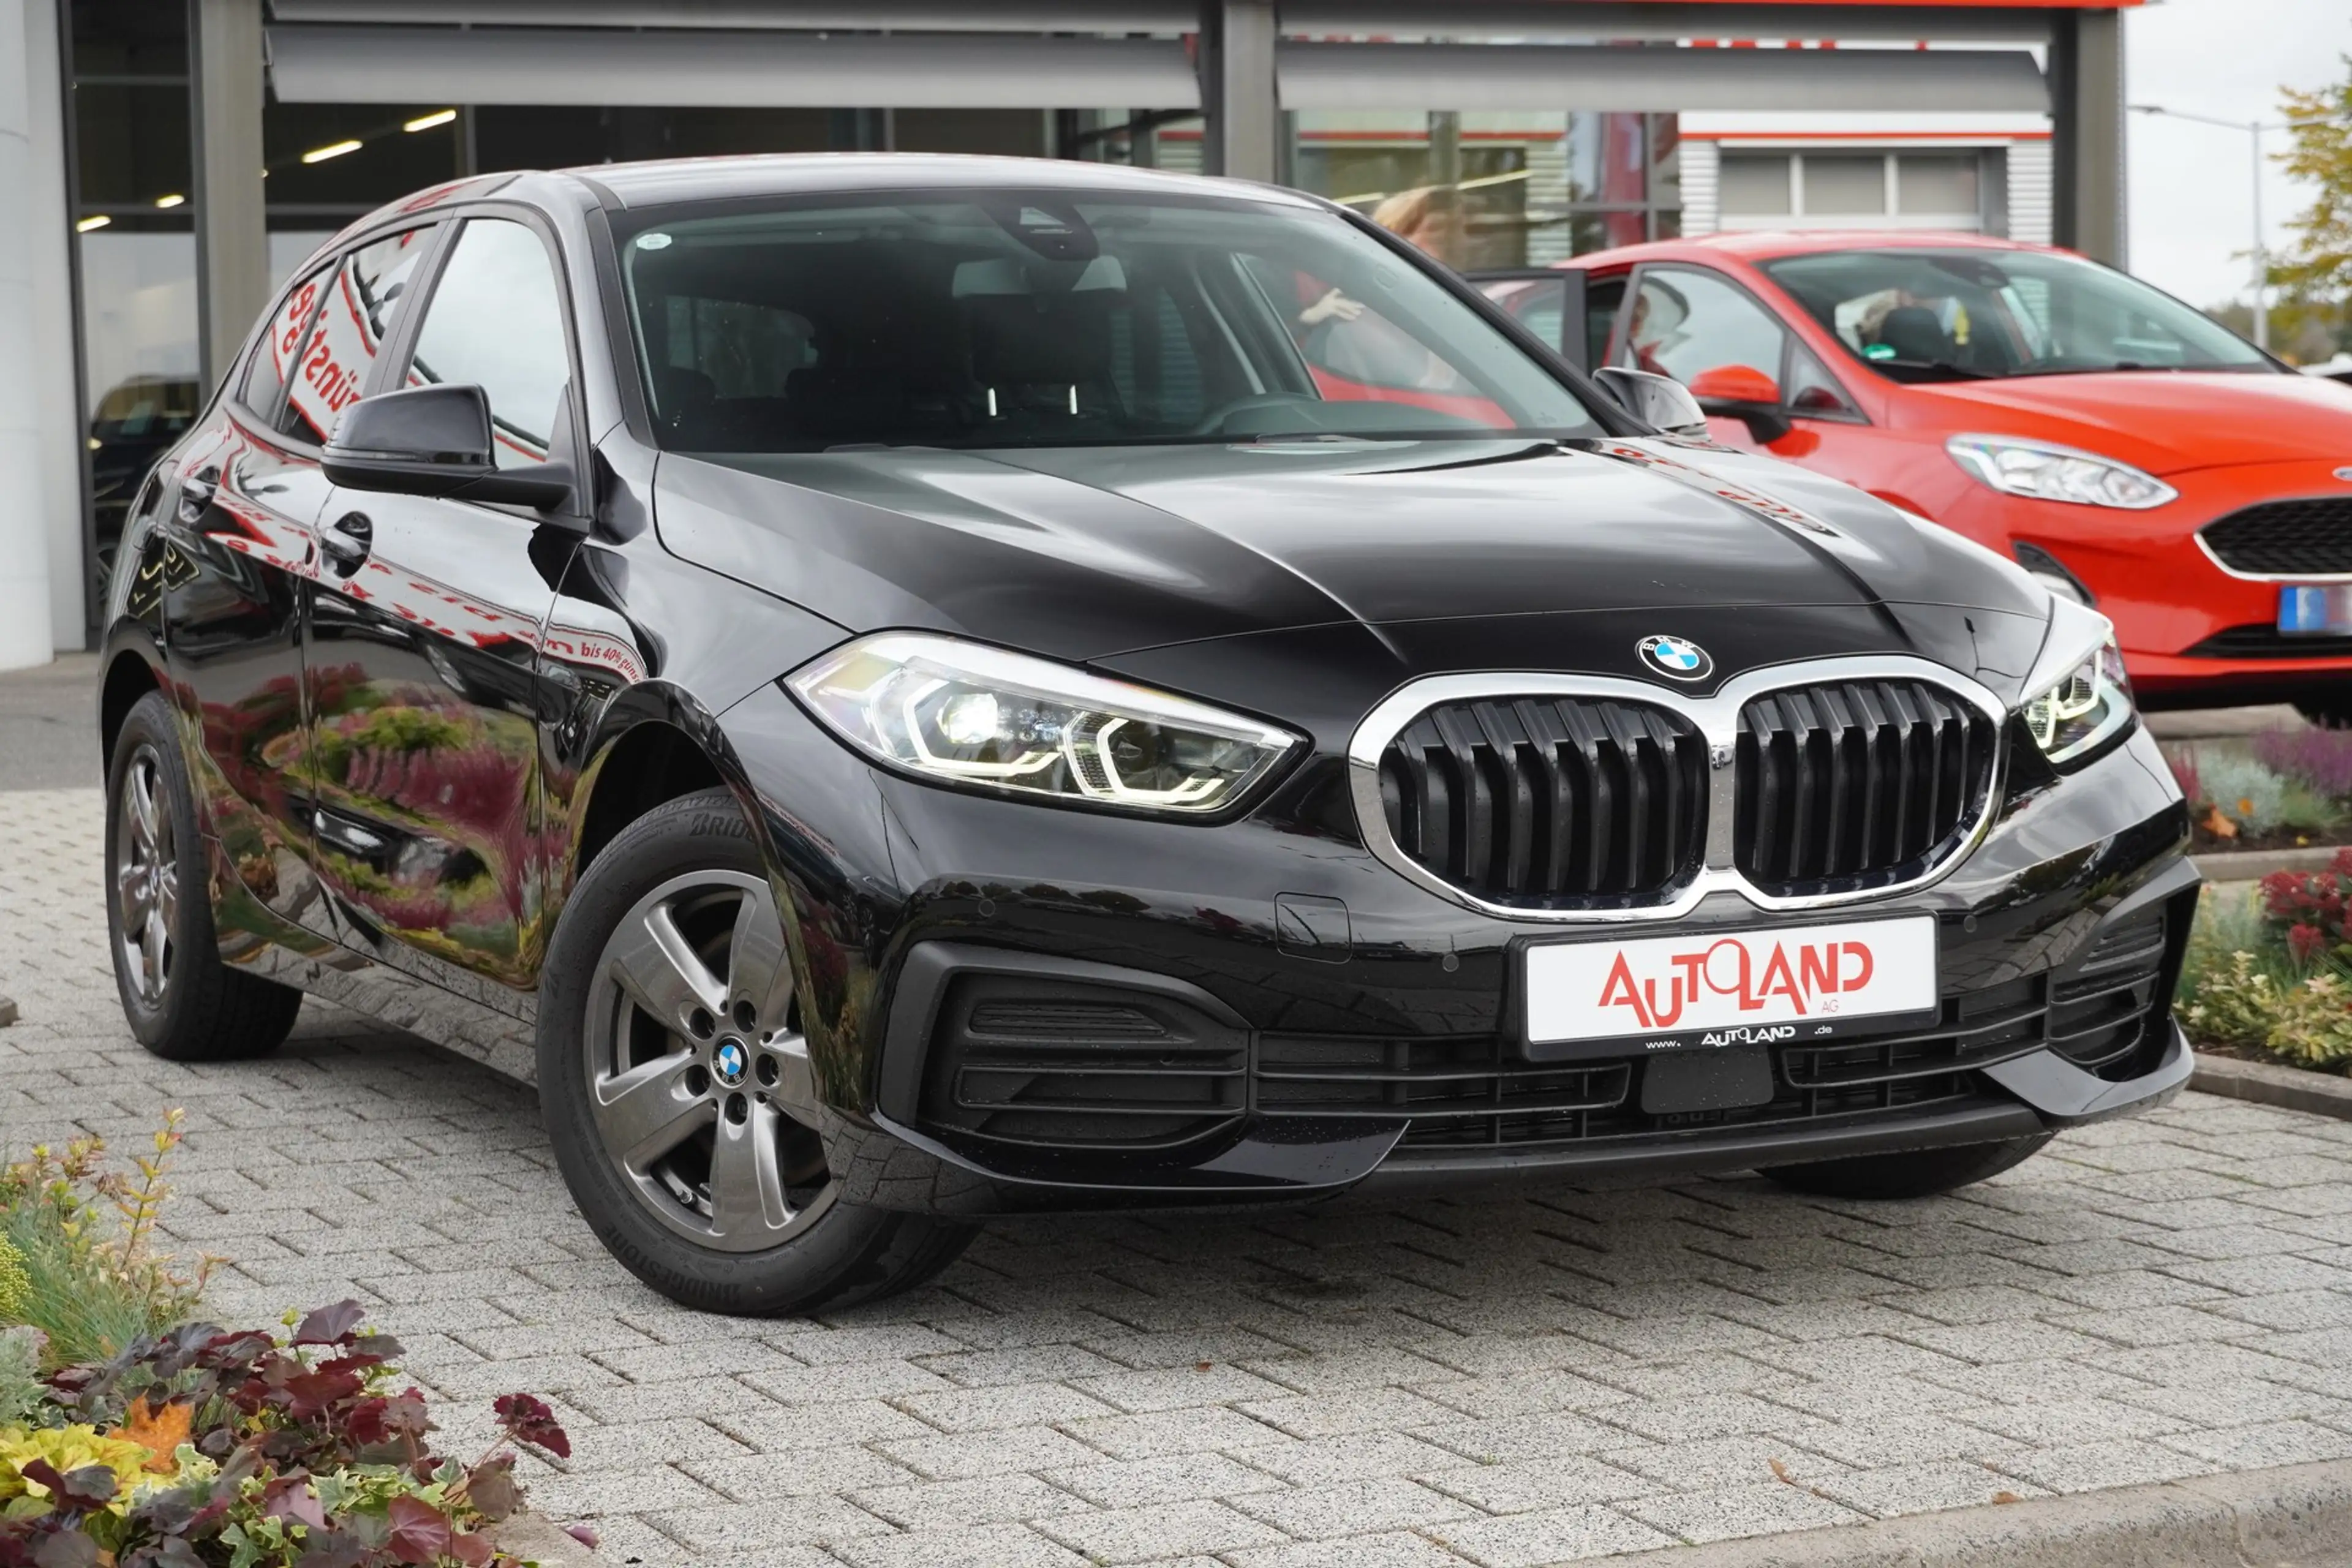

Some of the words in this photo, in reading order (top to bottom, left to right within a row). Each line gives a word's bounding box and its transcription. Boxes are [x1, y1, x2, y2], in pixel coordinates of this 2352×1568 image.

[581, 642, 601, 658] bis
[1599, 938, 1874, 1028] AUTOLAND
[1822, 999, 1840, 1014] AG
[1646, 1041, 1681, 1049] www.
[1702, 1026, 1796, 1047] AUTOLAND
[1814, 1025, 1833, 1035] .de
